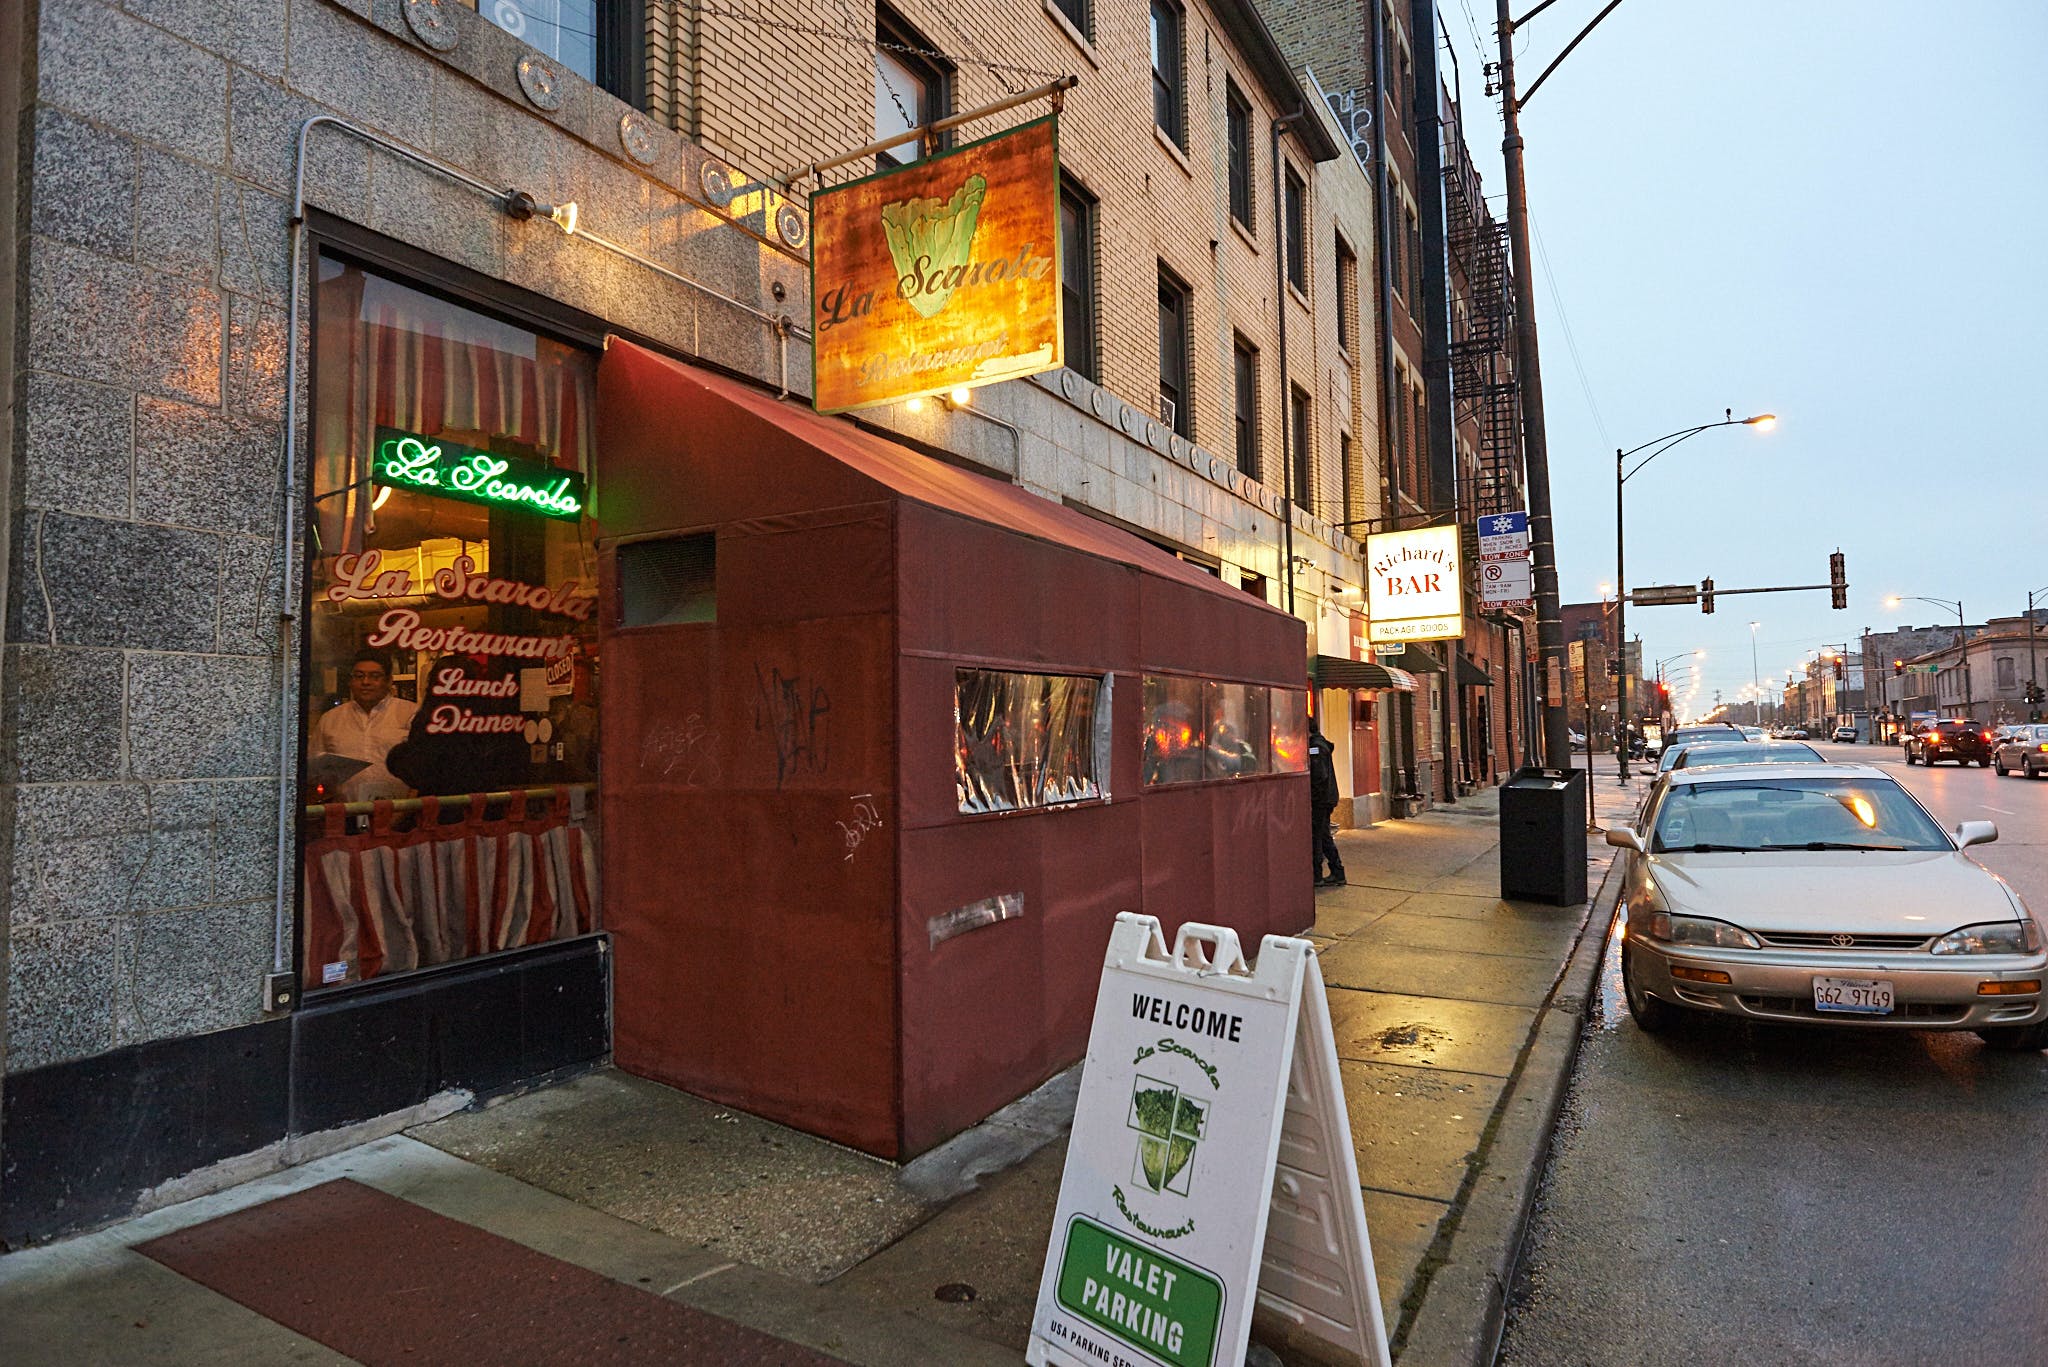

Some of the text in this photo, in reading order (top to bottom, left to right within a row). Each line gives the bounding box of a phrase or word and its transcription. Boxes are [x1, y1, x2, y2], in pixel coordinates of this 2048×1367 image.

[819, 242, 1052, 332] La Scarola
[386, 438, 581, 513] La Scarola
[1374, 546, 1455, 577] Richard's
[1484, 550, 1525, 561] TOW ZONE
[328, 550, 594, 621] La Scarola
[1387, 573, 1441, 596] BAR
[1506, 598, 1527, 606] ZONE
[368, 608, 578, 659] Restaurant
[1379, 623, 1449, 635] PACKAGE GOODS
[431, 667, 519, 698] Lunch
[547, 656, 571, 683] CLOSED
[426, 704, 526, 735] Dinner
[1132, 993, 1243, 1043] WELCOME
[1852, 989, 1890, 1007] 9749
[1133, 1038, 1220, 1091] La Scarola
[1112, 1184, 1195, 1239] Restaurant
[1106, 1244, 1177, 1302] VALET
[1082, 1276, 1184, 1355] PARKING
[1050, 1320, 1067, 1338] USA
[1071, 1332, 1110, 1362] PARKING
